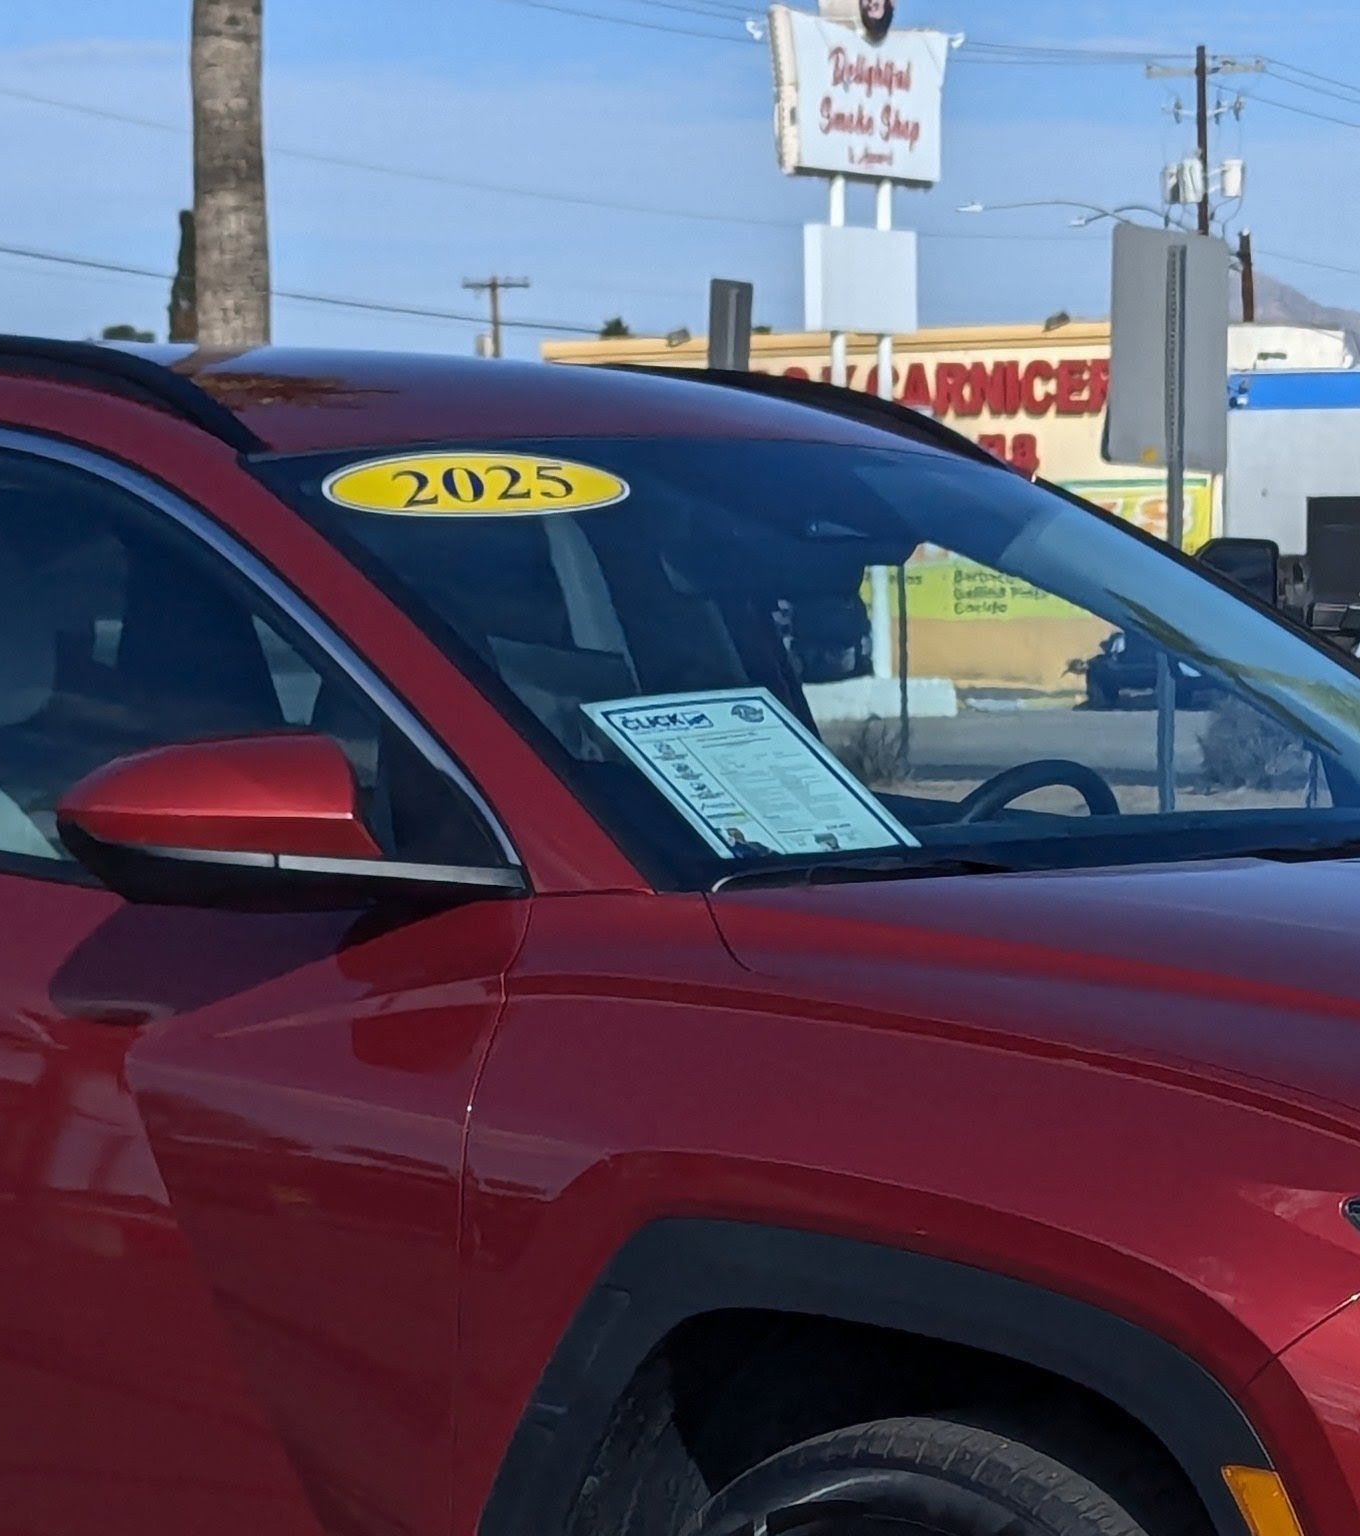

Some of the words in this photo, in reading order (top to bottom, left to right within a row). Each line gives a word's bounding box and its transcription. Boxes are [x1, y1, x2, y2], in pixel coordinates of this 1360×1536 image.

[828, 46, 911, 98] Delightful
[819, 96, 874, 135] Smoke
[880, 104, 920, 151] Shop
[392, 465, 574, 508] 2025
